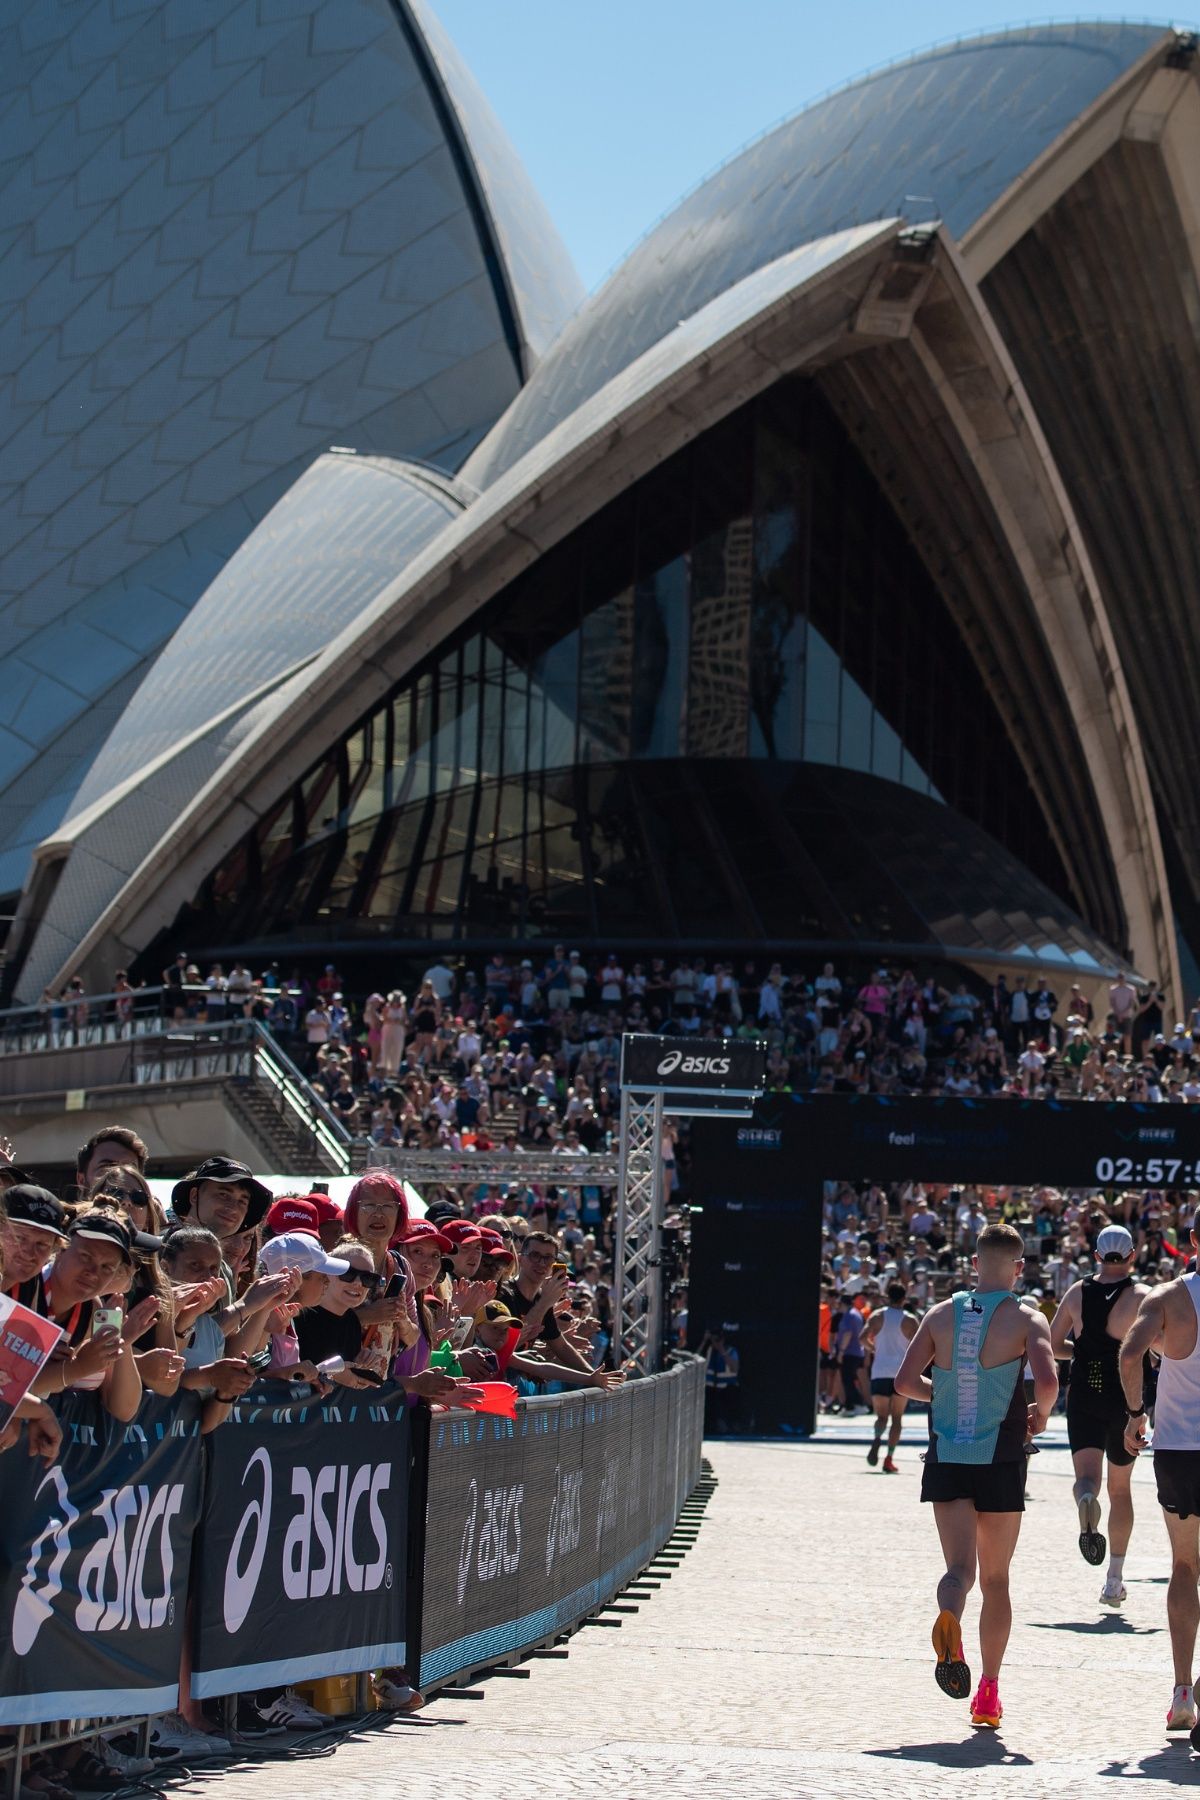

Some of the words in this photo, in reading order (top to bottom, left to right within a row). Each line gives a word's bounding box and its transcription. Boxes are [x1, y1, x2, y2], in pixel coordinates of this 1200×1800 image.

[681, 1056, 731, 1074] asics
[737, 1128, 782, 1141] SYDNEY
[888, 1131, 915, 1146] feel
[4, 1331, 46, 1366] TEAM!
[283, 1463, 392, 1600] asics
[75, 1483, 184, 1632] asics
